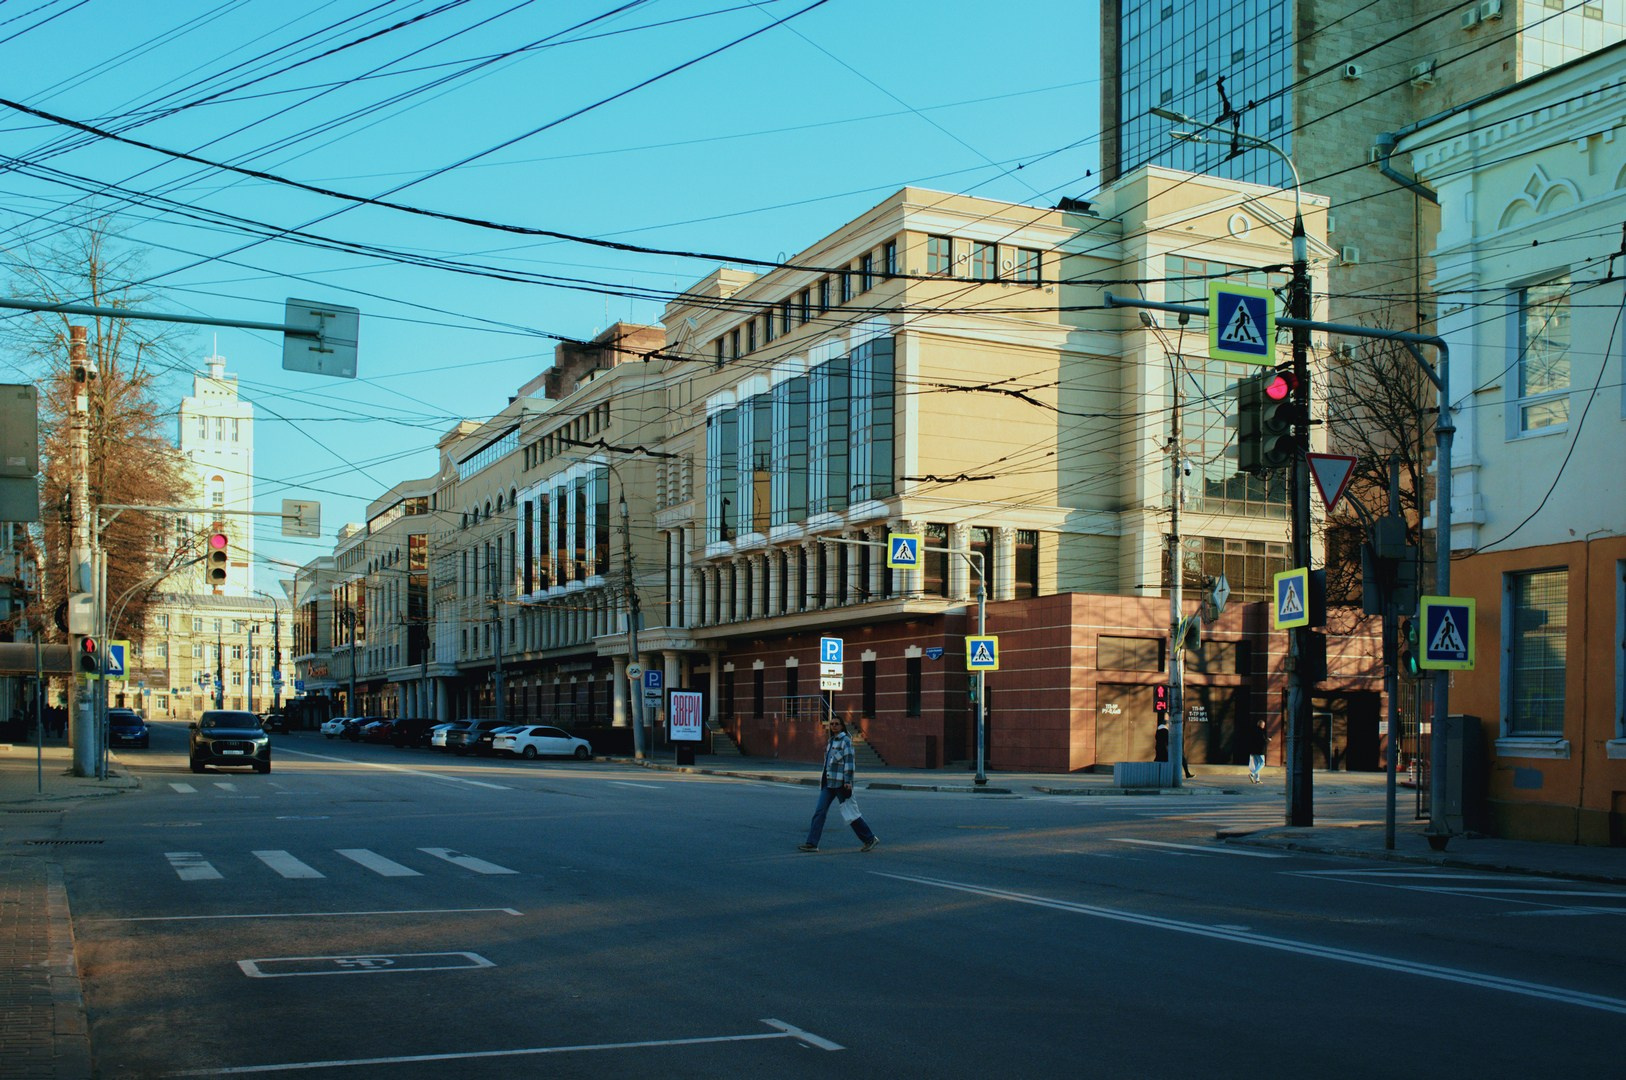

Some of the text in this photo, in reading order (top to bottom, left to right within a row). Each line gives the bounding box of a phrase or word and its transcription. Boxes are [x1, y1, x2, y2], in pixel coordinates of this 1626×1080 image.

[826, 640, 839, 660] P
[649, 672, 659, 686] P
[673, 694, 701, 728] ЗВЕРИ
[1156, 701, 1166, 710] 24
